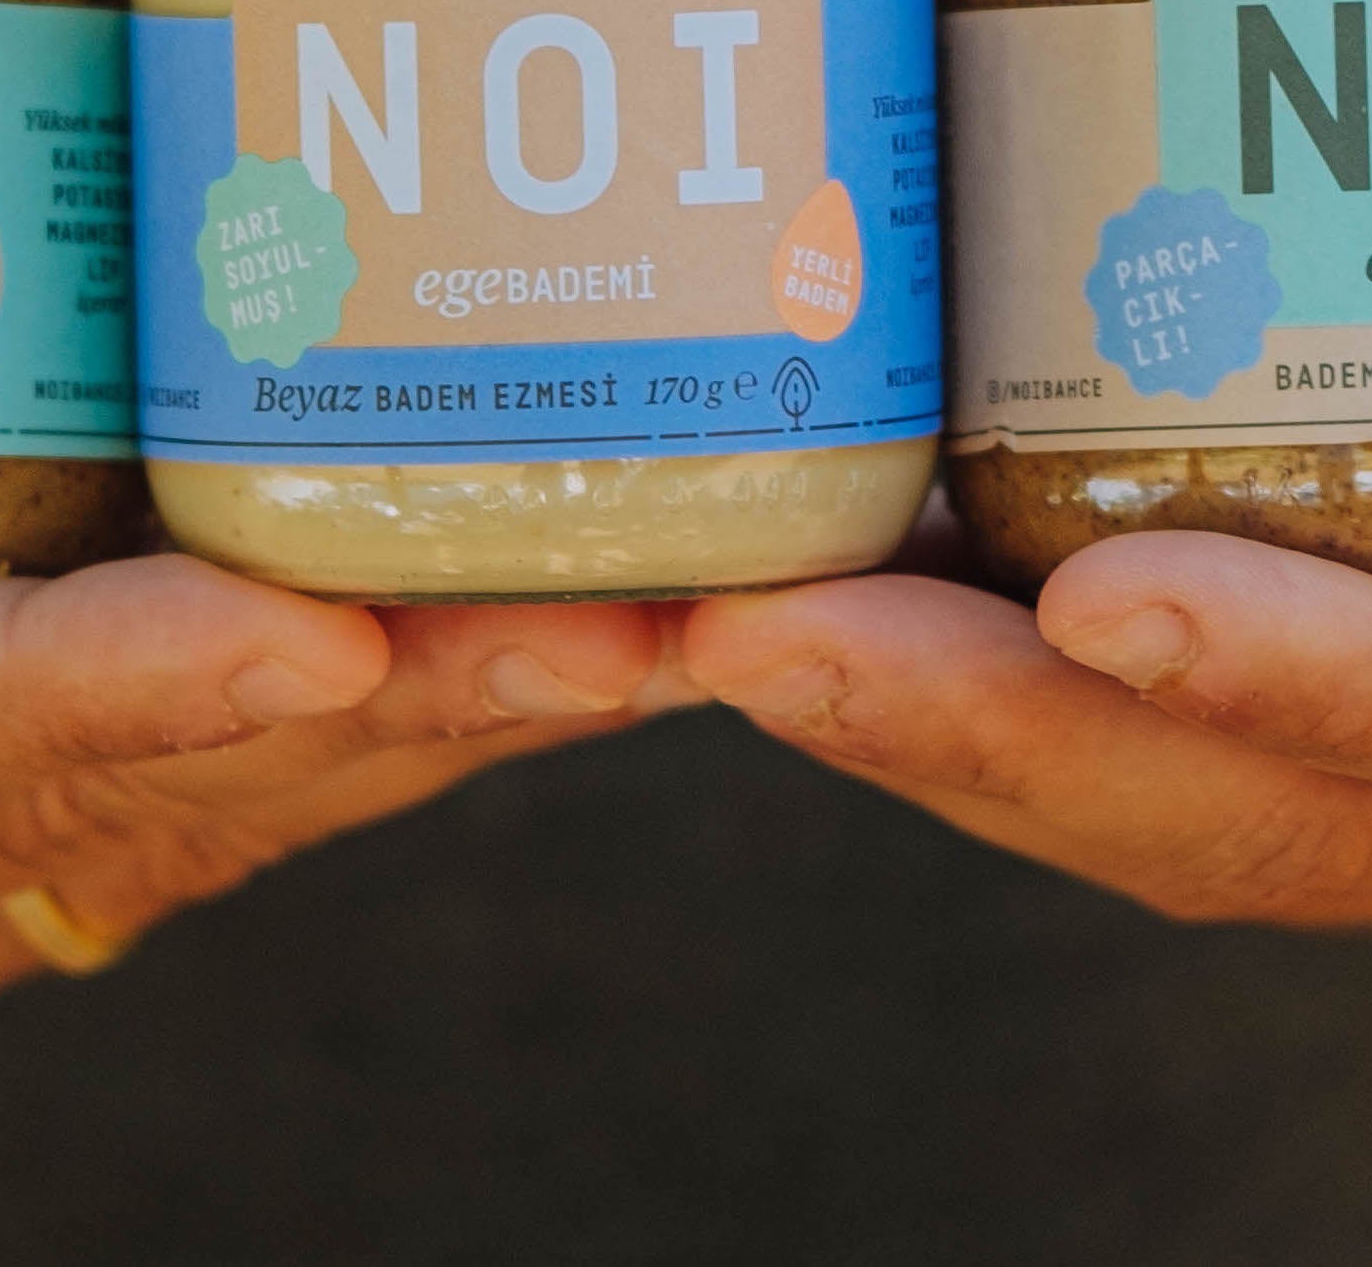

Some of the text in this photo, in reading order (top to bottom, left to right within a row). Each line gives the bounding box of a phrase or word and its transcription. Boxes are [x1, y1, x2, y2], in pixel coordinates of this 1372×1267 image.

[296, 9, 764, 215] NOI
[218, 205, 283, 251] ZARI
[1114, 236, 1239, 290] PARÇA-
[784, 274, 850, 316] BADEM
[1124, 285, 1204, 328] CIK-
[1132, 324, 1190, 366] LI!
[253, 377, 363, 421] Beyaz
[377, 384, 476, 412] BADEM
[494, 373, 618, 410] EZMESİ
